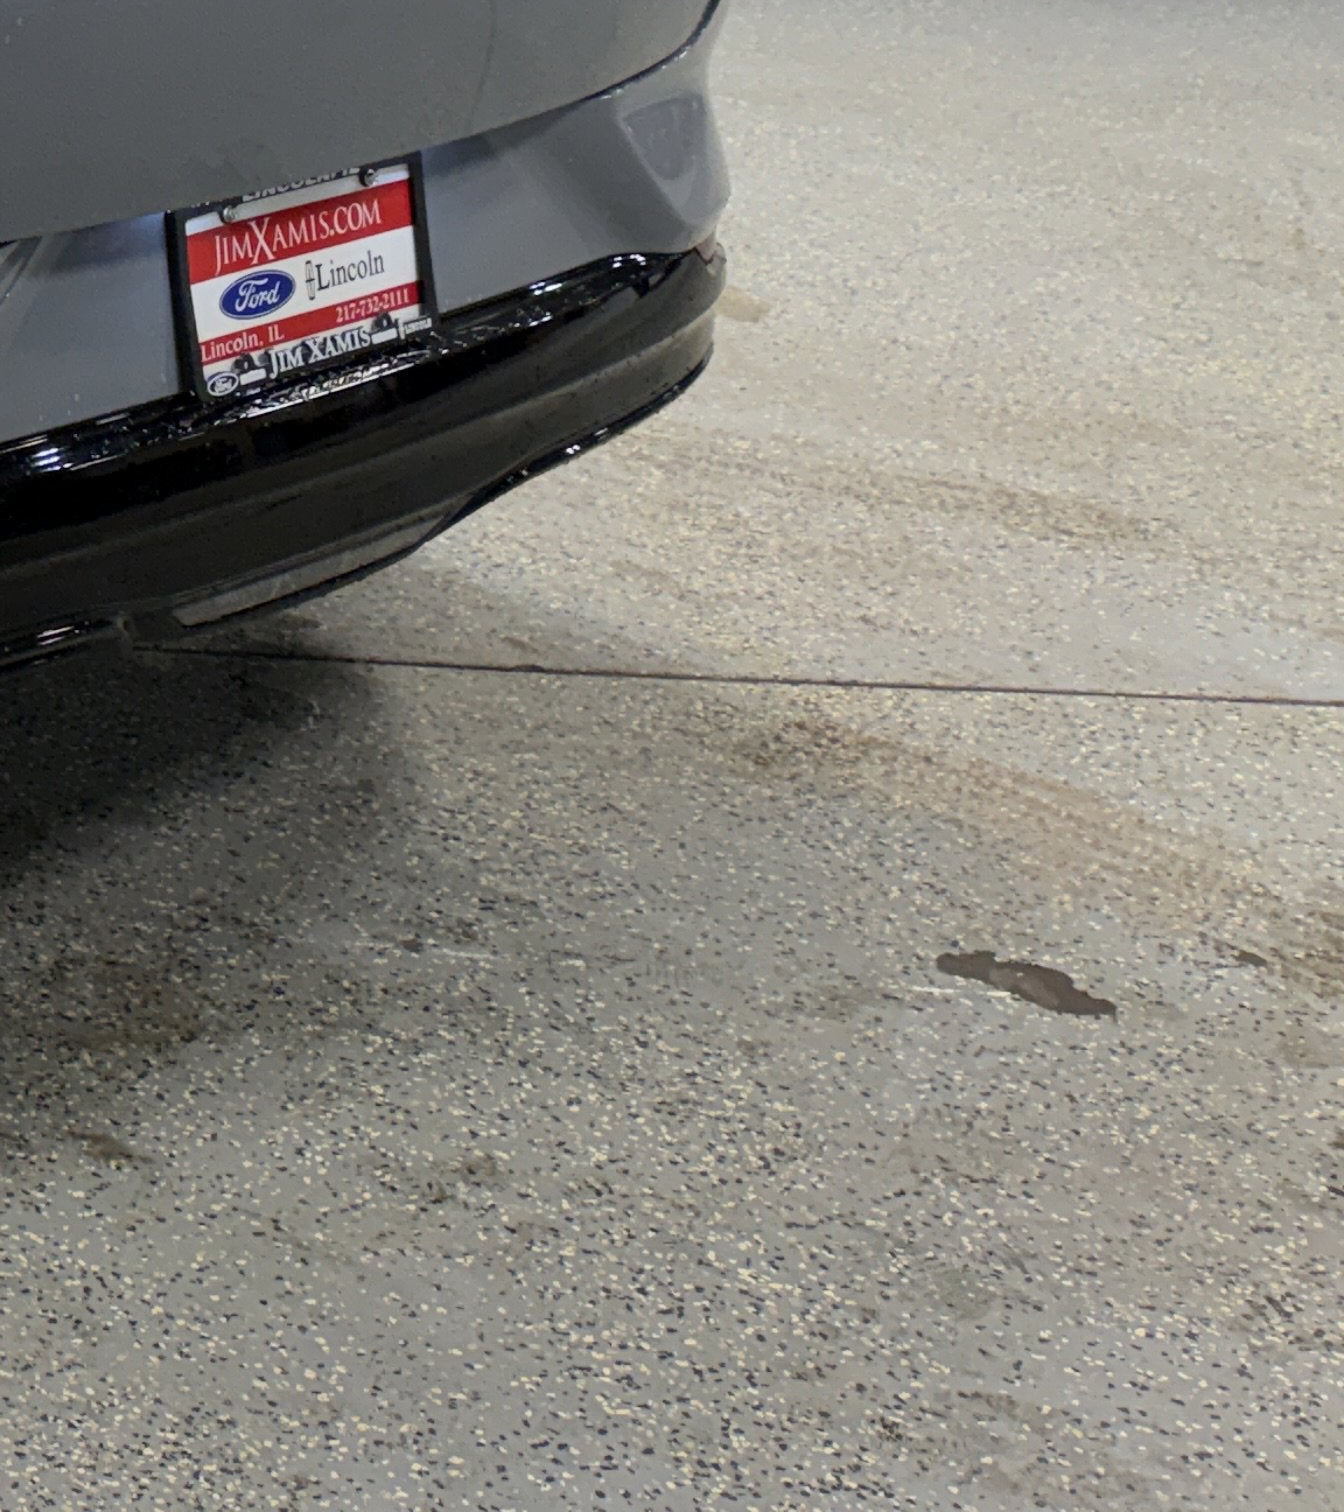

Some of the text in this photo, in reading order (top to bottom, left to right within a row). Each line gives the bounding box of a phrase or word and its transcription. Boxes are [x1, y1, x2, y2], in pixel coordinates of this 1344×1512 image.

[315, 249, 385, 292] Lincoln
[335, 288, 411, 324] 217-732-2111
[267, 327, 372, 379] JIM XAMIS
[268, 324, 285, 343] IL
